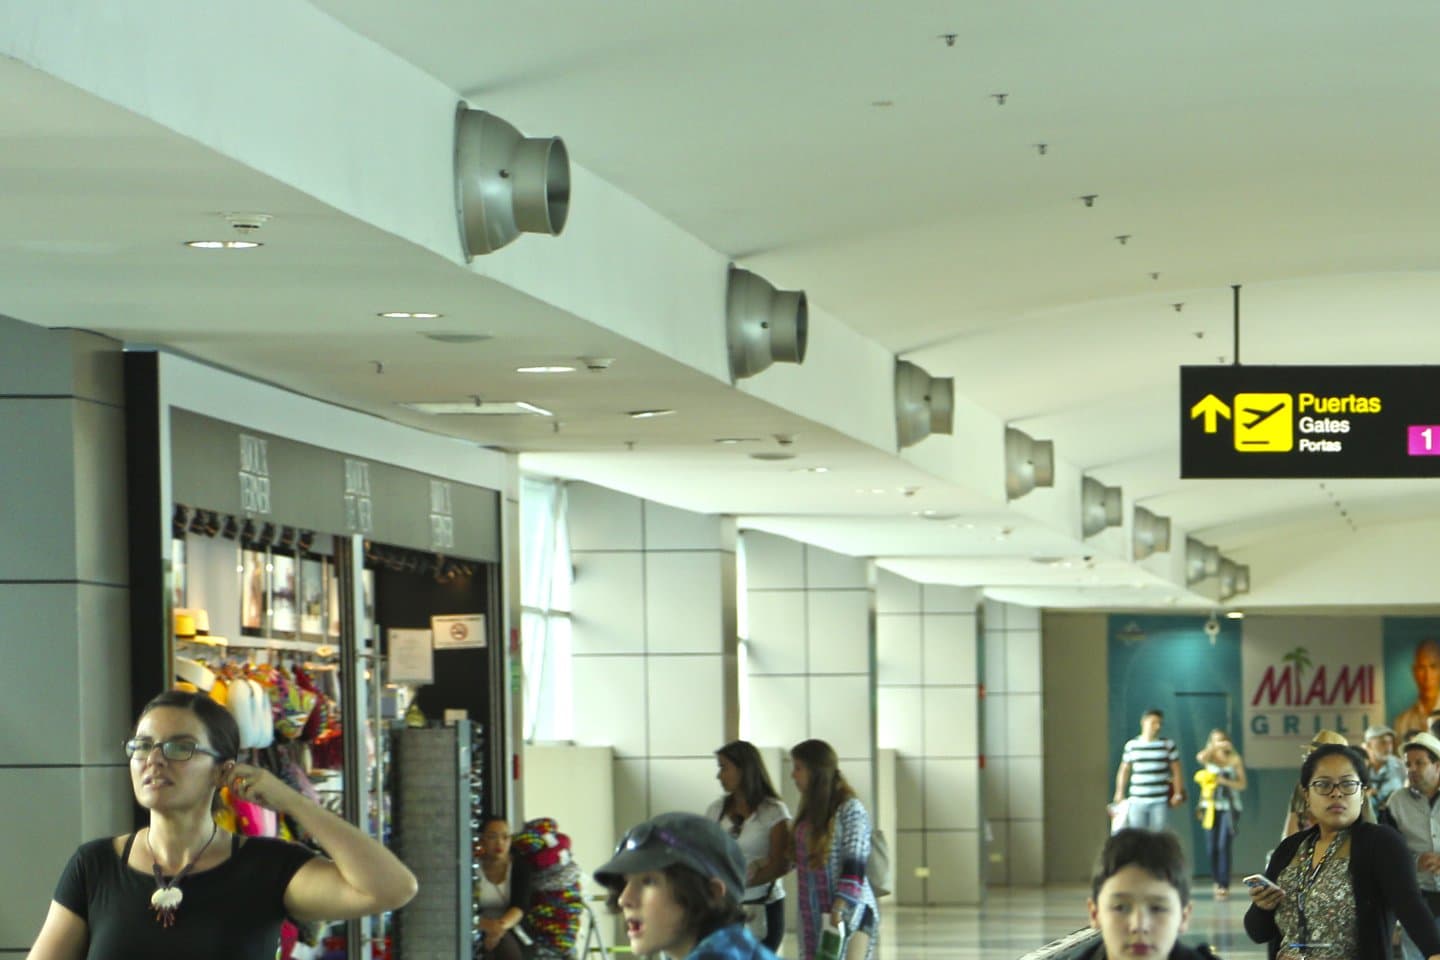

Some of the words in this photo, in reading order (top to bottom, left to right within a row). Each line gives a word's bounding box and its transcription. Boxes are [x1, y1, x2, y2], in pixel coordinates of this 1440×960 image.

[1298, 392, 1382, 414] Puertas
[1298, 416, 1351, 433] Gates
[1298, 438, 1342, 452] Portas
[1420, 427, 1432, 451] 1
[1251, 664, 1376, 706] MIAMI
